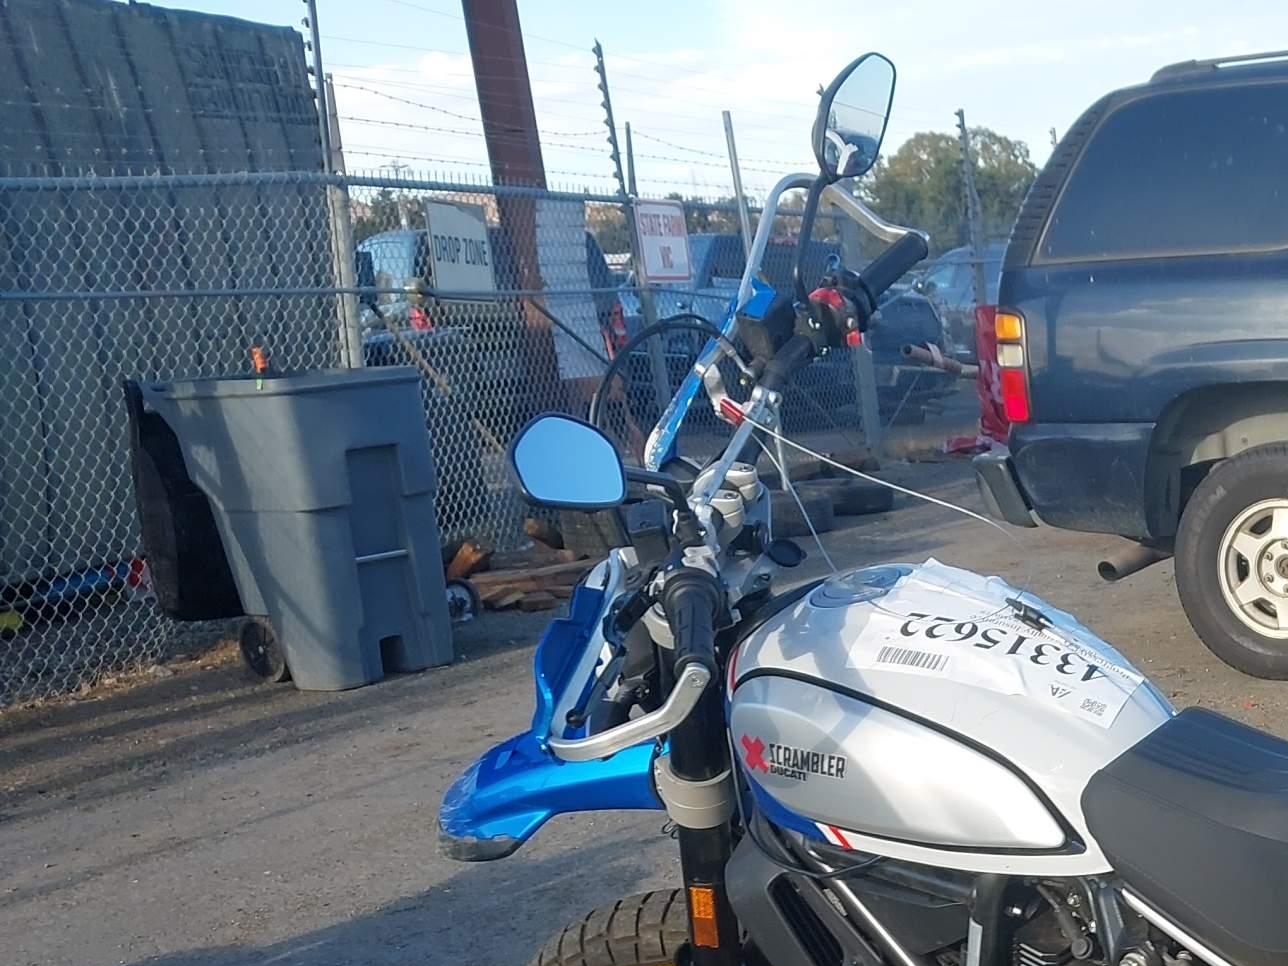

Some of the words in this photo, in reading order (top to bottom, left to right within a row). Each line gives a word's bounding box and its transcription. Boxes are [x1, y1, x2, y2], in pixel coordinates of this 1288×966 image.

[639, 212, 664, 237] STATE
[433, 234, 461, 264] DROP
[461, 237, 489, 266] ZONE
[899, 612, 1108, 682] 43315622
[768, 743, 847, 779] SCRAMBLER
[769, 764, 807, 781] DUCATI
